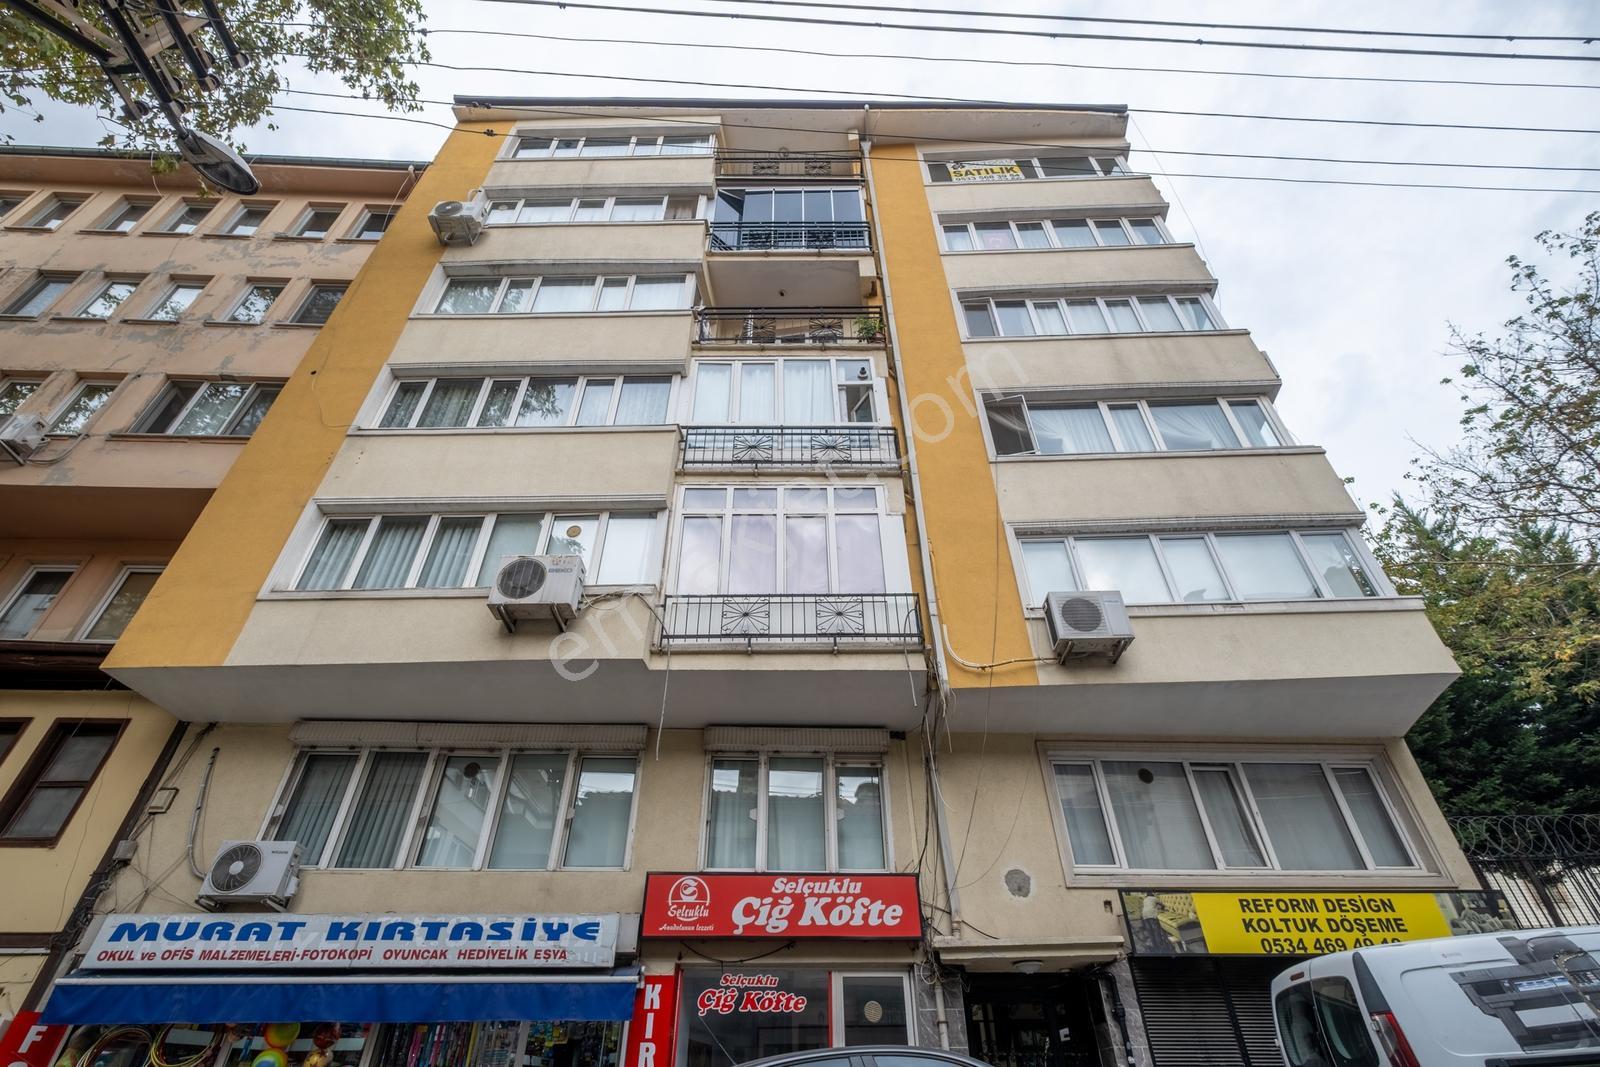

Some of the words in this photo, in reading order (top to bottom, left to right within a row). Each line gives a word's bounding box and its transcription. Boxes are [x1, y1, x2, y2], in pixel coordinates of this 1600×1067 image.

[952, 166, 1018, 178] SATILIK
[772, 877, 862, 897] Selçuklu
[1238, 898, 1320, 913] REFORM
[1321, 894, 1396, 913] DESİGN
[731, 896, 794, 935] Çiğ
[798, 896, 903, 926] Köfte
[108, 922, 307, 942] MURAT
[325, 917, 600, 941] KIRTASİYE
[1241, 917, 1323, 933] KOLTUK
[1325, 915, 1408, 937] DÖŞEME
[96, 950, 135, 962] OKUL
[140, 952, 157, 961] ve
[161, 947, 194, 961] OFİS
[382, 949, 448, 960] OYUNCAK
[456, 946, 528, 960] HEDİYELİK
[534, 949, 567, 963] EŞYA
[1260, 938, 1308, 954] 0534
[1313, 938, 1348, 953] 469
[719, 973, 779, 988] Selçuklu
[697, 987, 738, 1016] Çiğ
[739, 990, 807, 1014] Köfte
[7, 1025, 48, 1067] F
